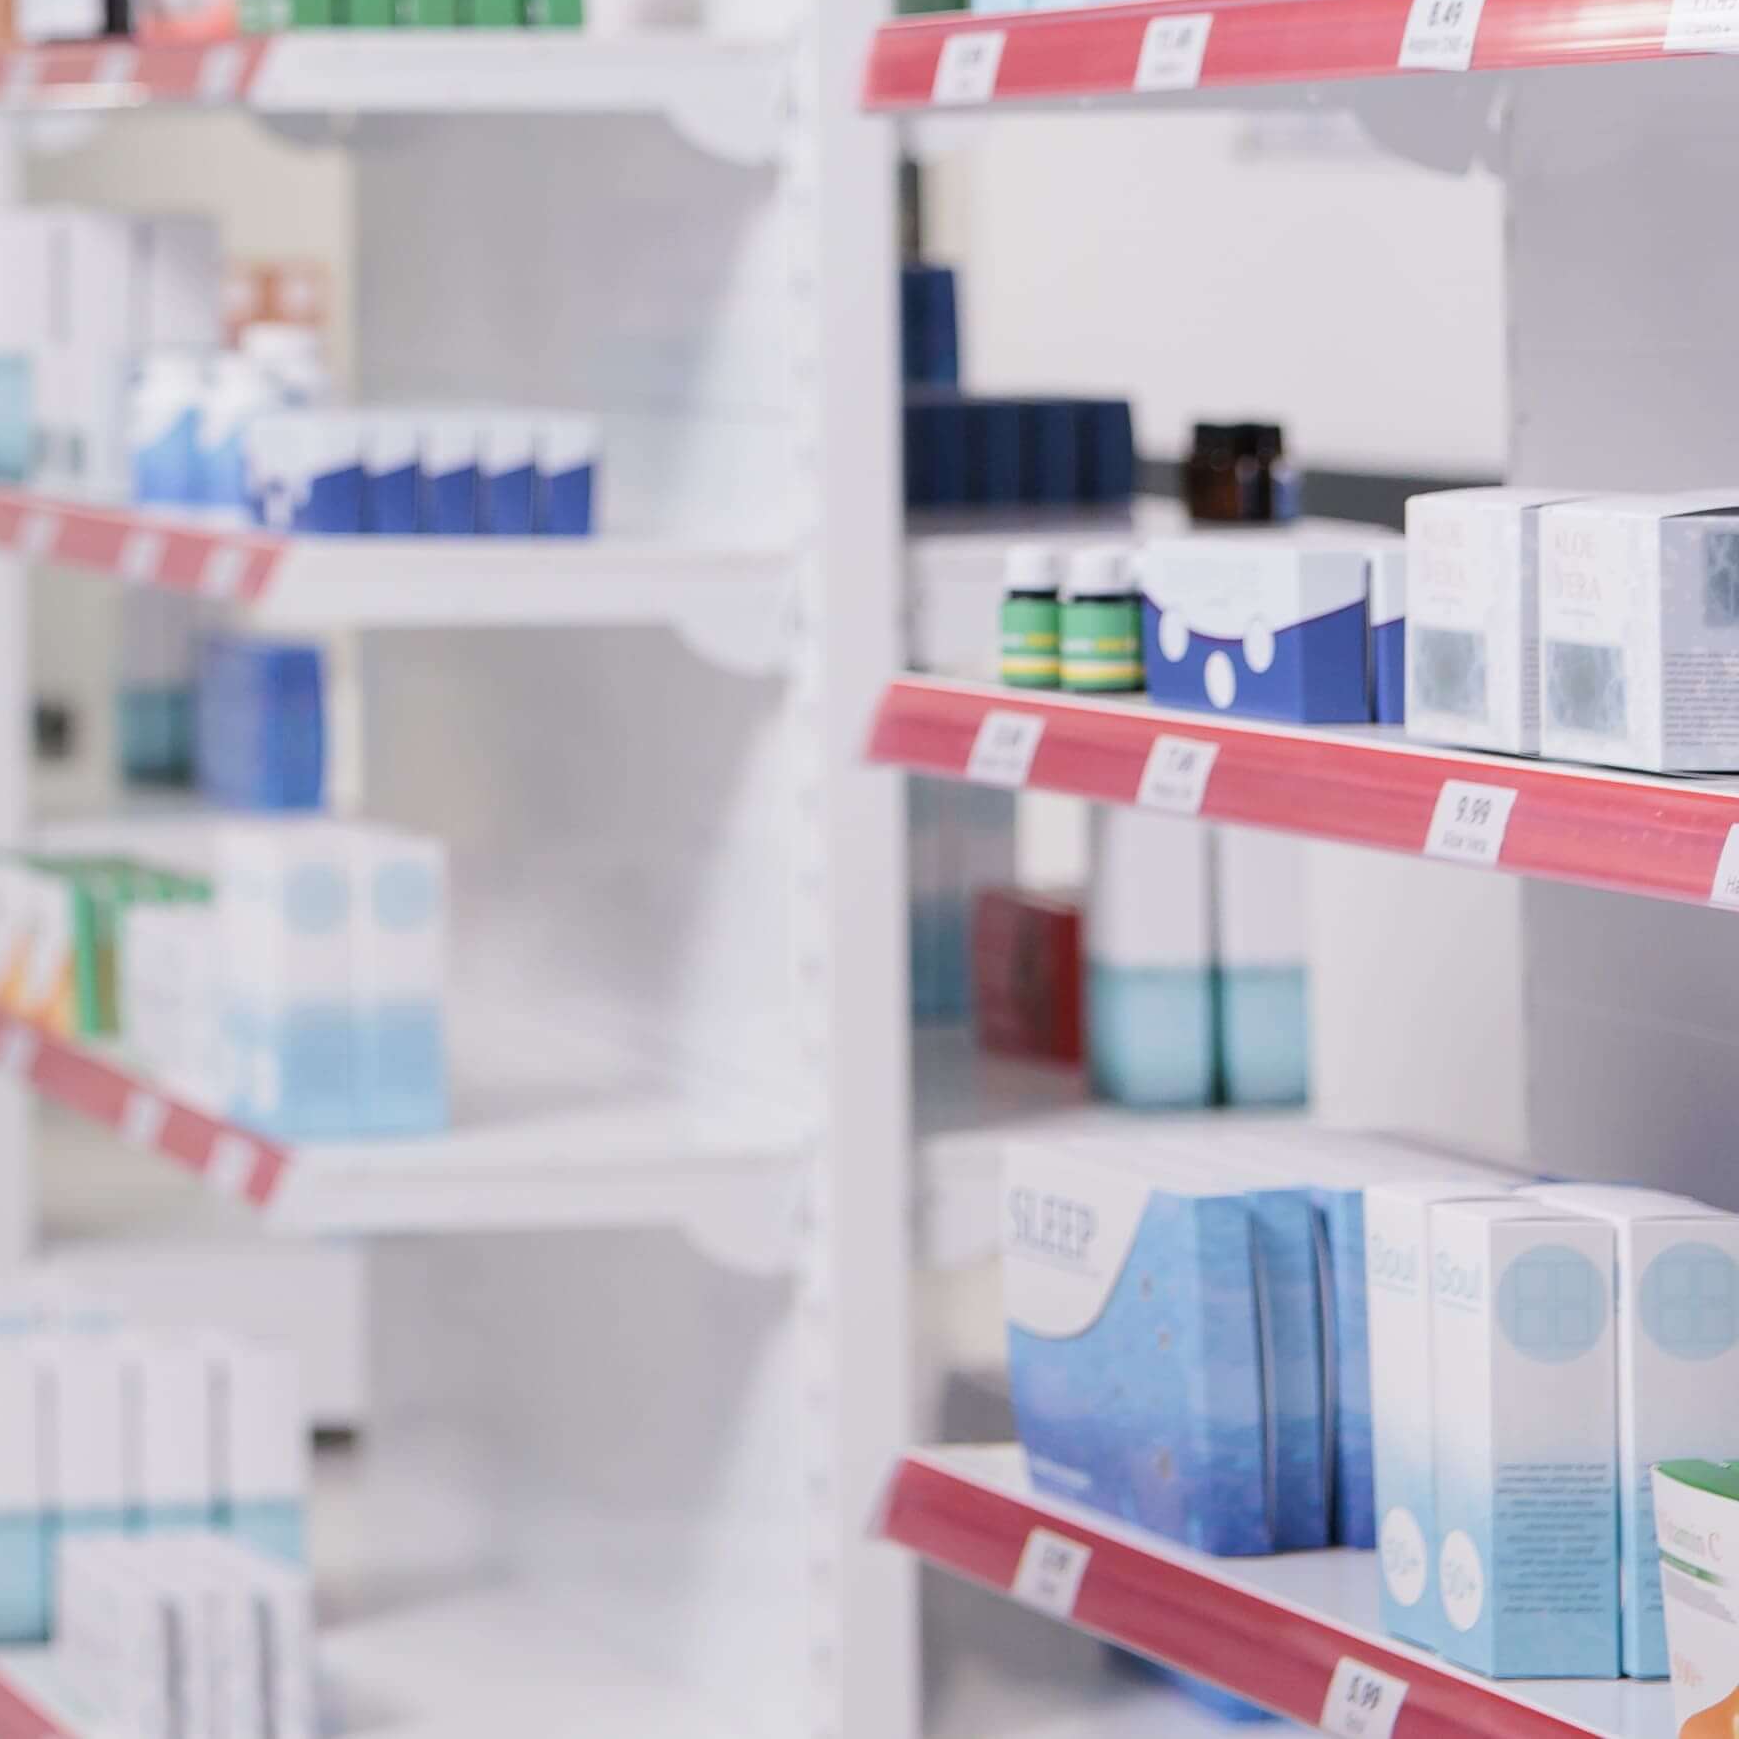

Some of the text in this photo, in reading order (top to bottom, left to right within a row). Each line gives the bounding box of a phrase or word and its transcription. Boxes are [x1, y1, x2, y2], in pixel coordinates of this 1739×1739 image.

[1455, 795, 1492, 824] 9.99
[1009, 1188, 1098, 1262] SLEEP
[1435, 1250, 1482, 1299] Soul
[1708, 1531, 1723, 1562] C
